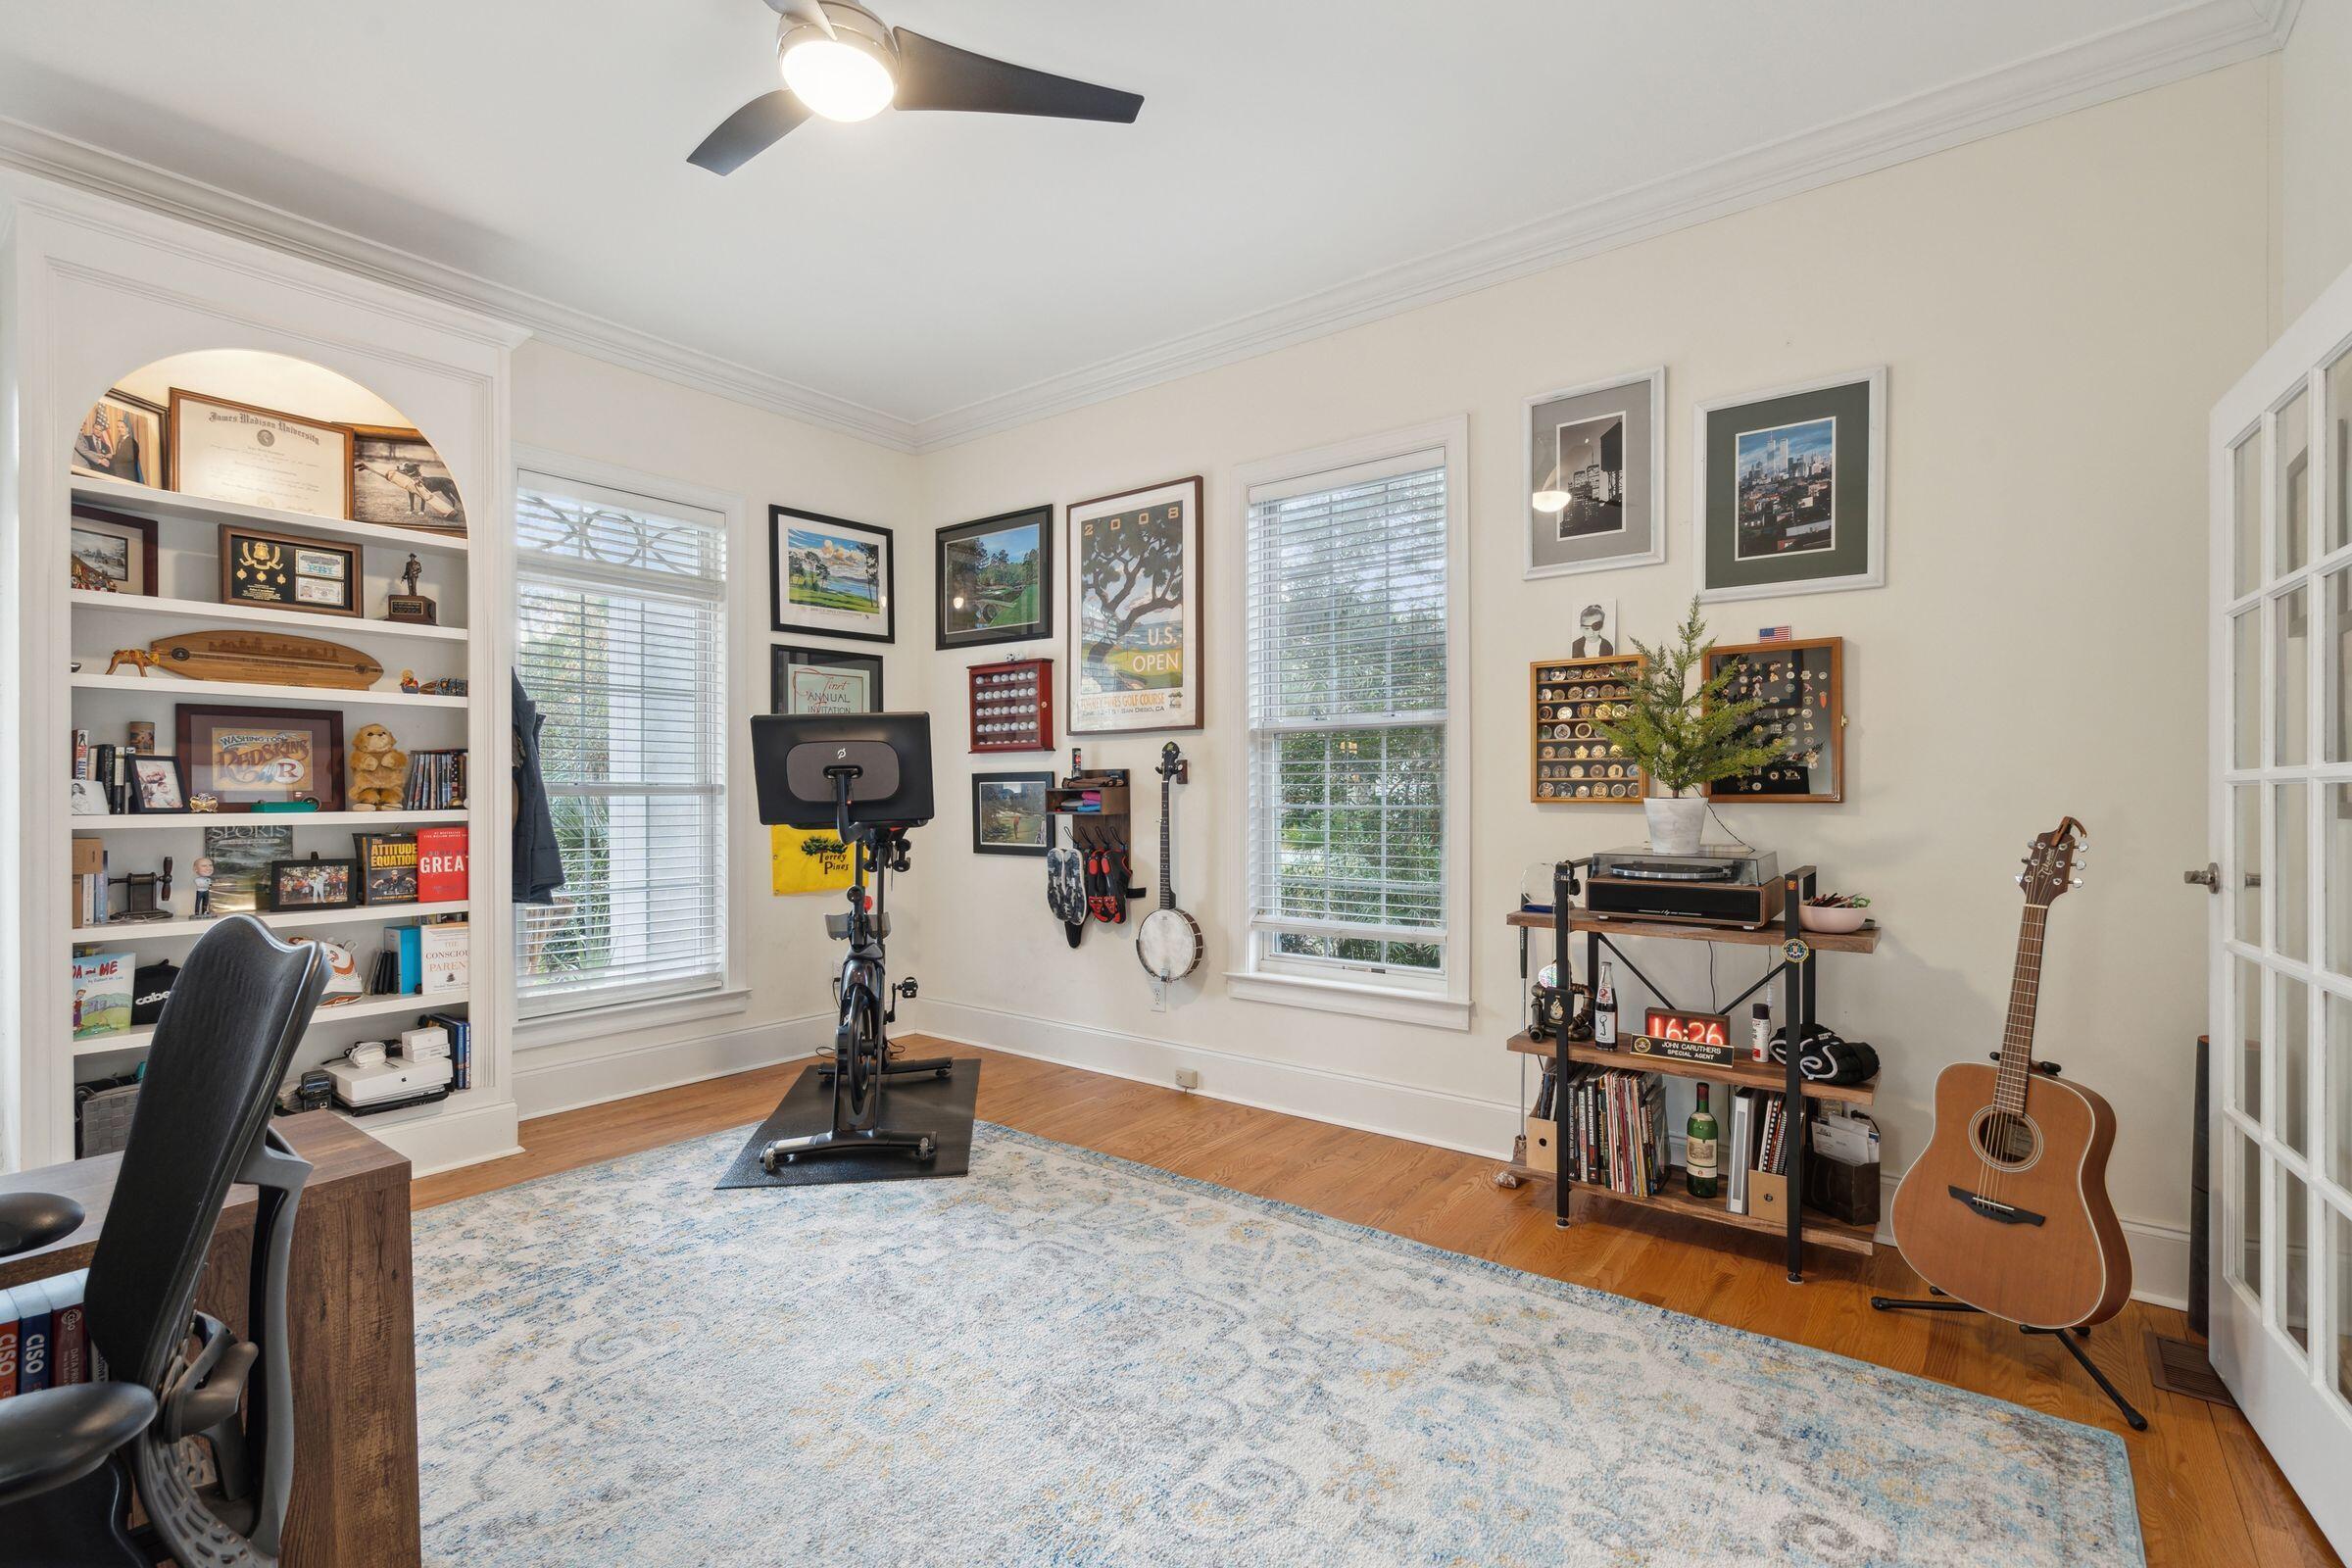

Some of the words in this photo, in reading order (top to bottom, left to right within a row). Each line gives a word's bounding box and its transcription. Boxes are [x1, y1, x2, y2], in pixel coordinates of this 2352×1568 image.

[208, 412, 238, 422] James
[239, 413, 276, 429] Madison
[277, 420, 320, 445] University
[1148, 626, 1177, 646] U.S.
[1132, 652, 1179, 673] OPEN
[808, 692, 851, 703] ANNUAL
[1122, 693, 1139, 706] GOLF
[1140, 692, 1165, 706] COURSE
[220, 735, 287, 746] WASHINGTON
[217, 739, 310, 783] REDSKINS
[277, 762, 298, 778] R
[370, 843, 417, 856] ATTITUDE
[815, 850, 847, 863] Torrey
[370, 855, 417, 867] EQUATION
[419, 856, 468, 874] GREA
[824, 861, 849, 874] Pines
[425, 950, 468, 959] CONSCIOU
[99, 960, 118, 976] ME
[429, 961, 467, 972] PAREN
[135, 990, 172, 1005] cabe
[1654, 1017, 1724, 1046] 16:26
[1667, 1049, 1691, 1057] SPECIAL
[1681, 1043, 1722, 1054] CARUTHERS
[67, 1313, 75, 1331] CISO
[0, 1334, 17, 1376] CISO
[25, 1333, 45, 1374] CISO
[71, 1367, 79, 1383] PRIV
